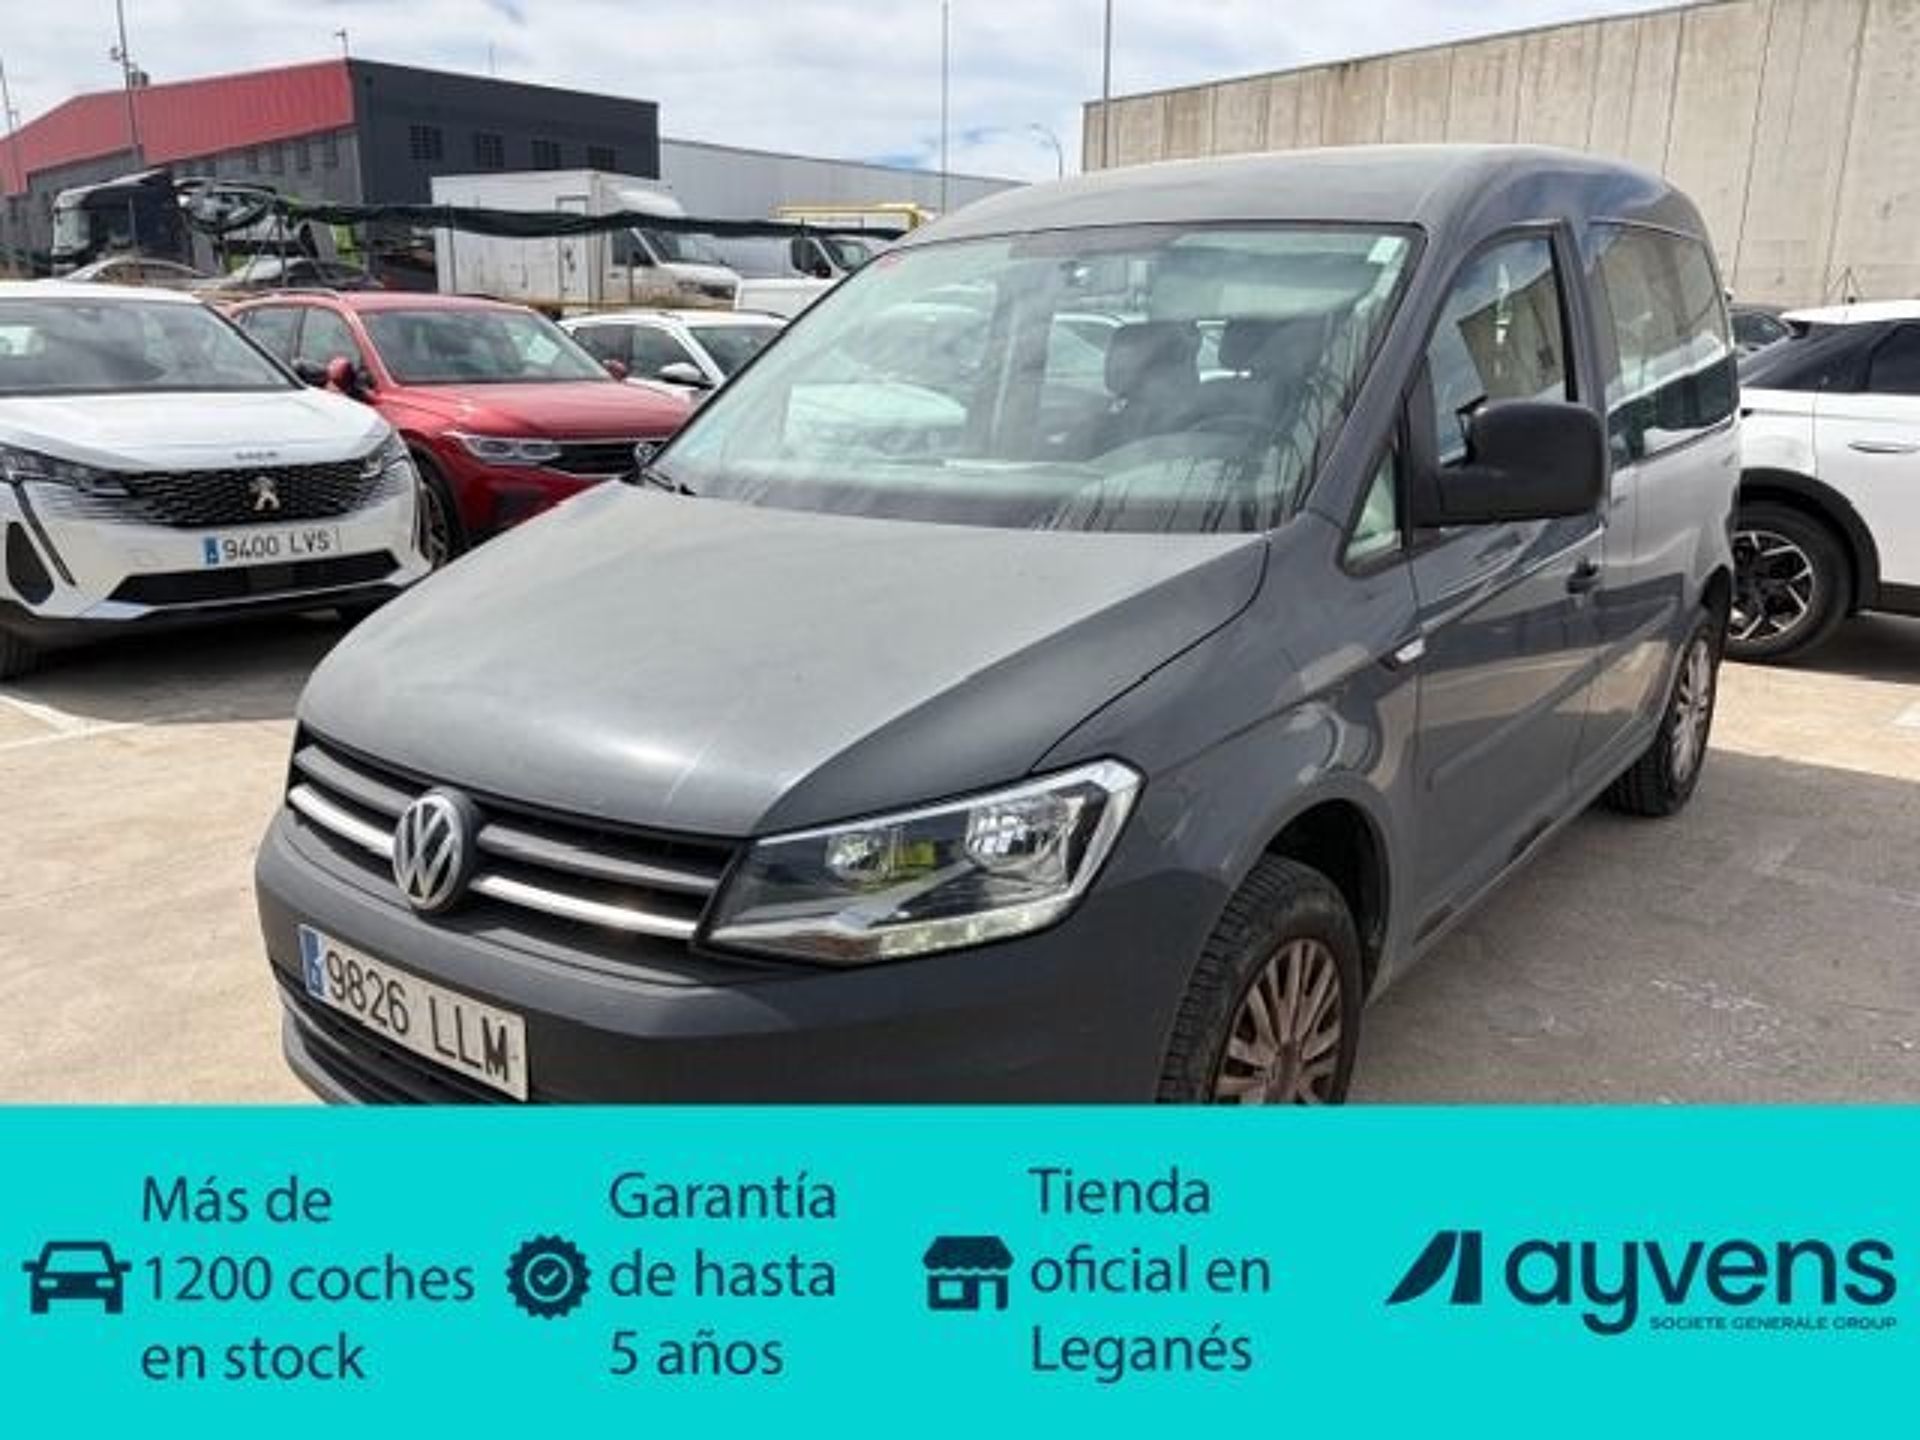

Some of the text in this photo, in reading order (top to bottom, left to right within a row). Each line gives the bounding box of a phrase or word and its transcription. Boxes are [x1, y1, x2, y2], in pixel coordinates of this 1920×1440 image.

[222, 535, 280, 560] 9400
[290, 528, 330, 553] LVS
[326, 949, 509, 1082] 9826 LLM
